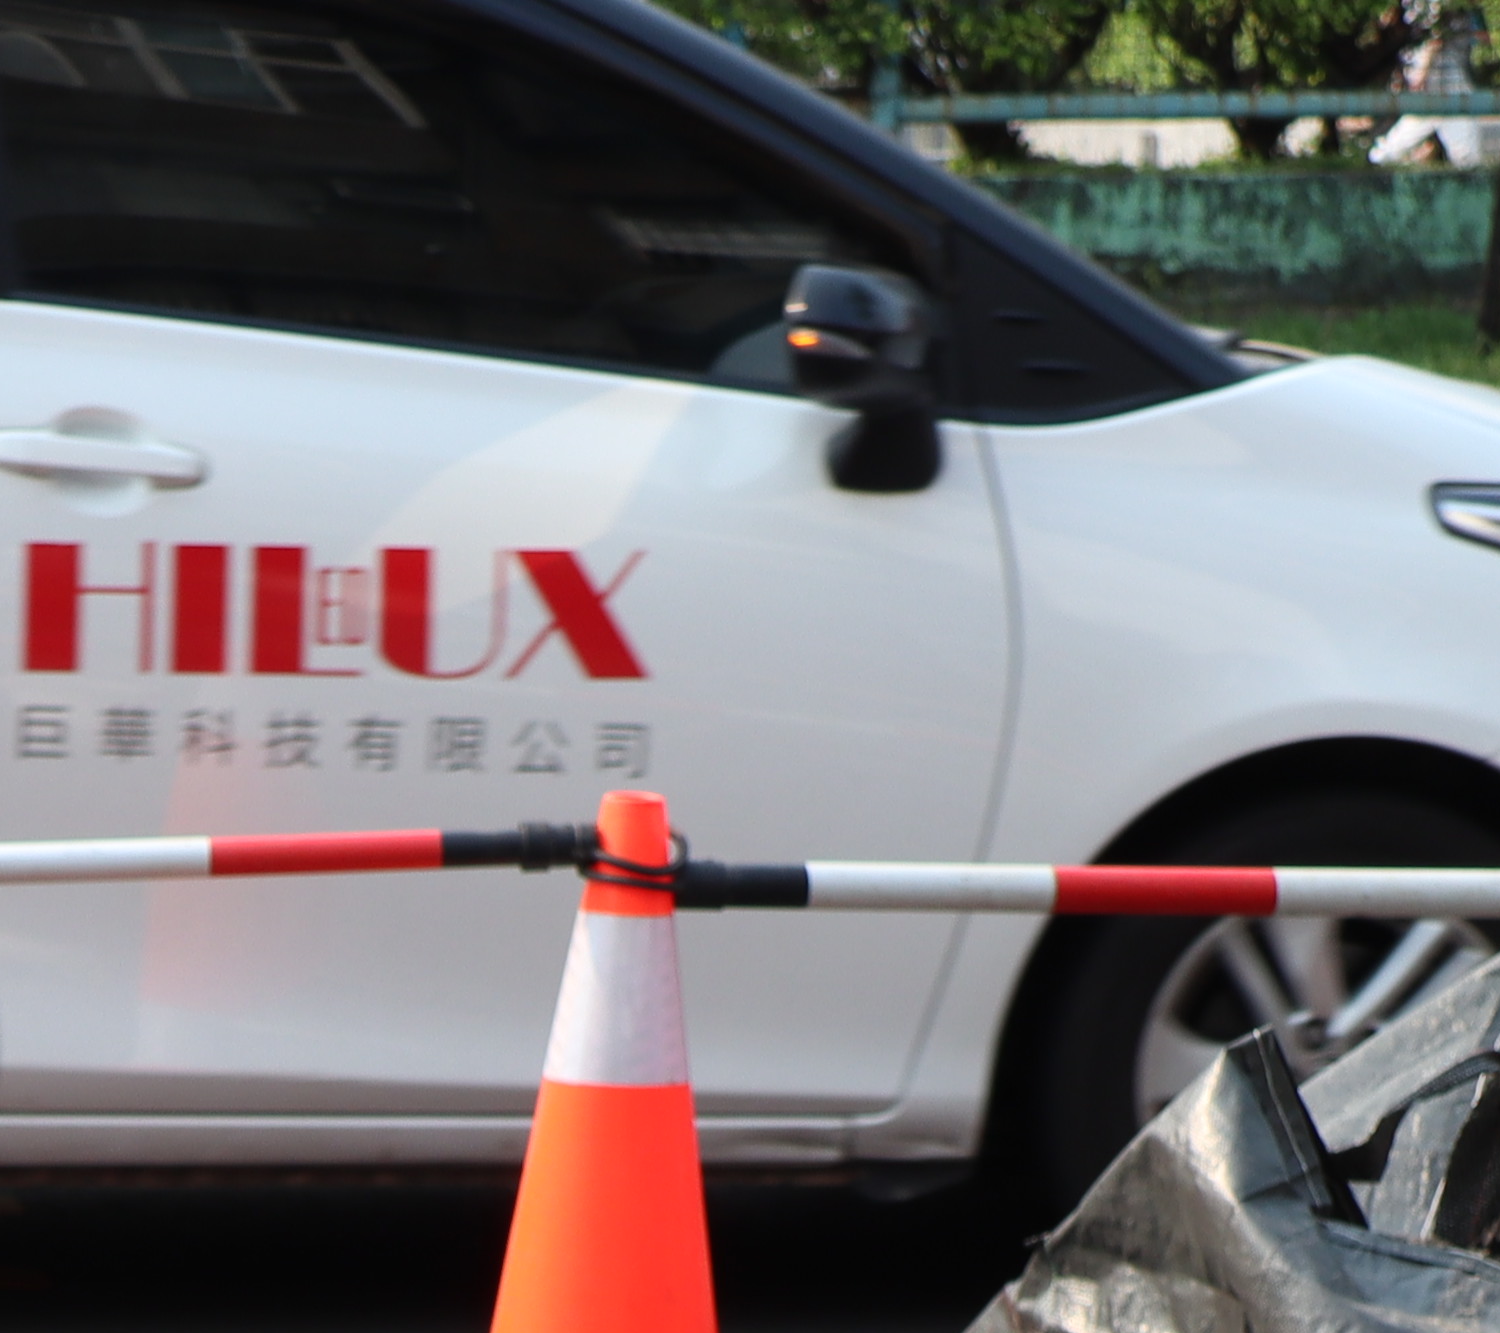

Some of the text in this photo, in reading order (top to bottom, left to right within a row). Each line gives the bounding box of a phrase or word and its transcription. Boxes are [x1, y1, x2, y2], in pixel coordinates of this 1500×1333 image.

[14, 704, 652, 778] 巨華科技有限公司
